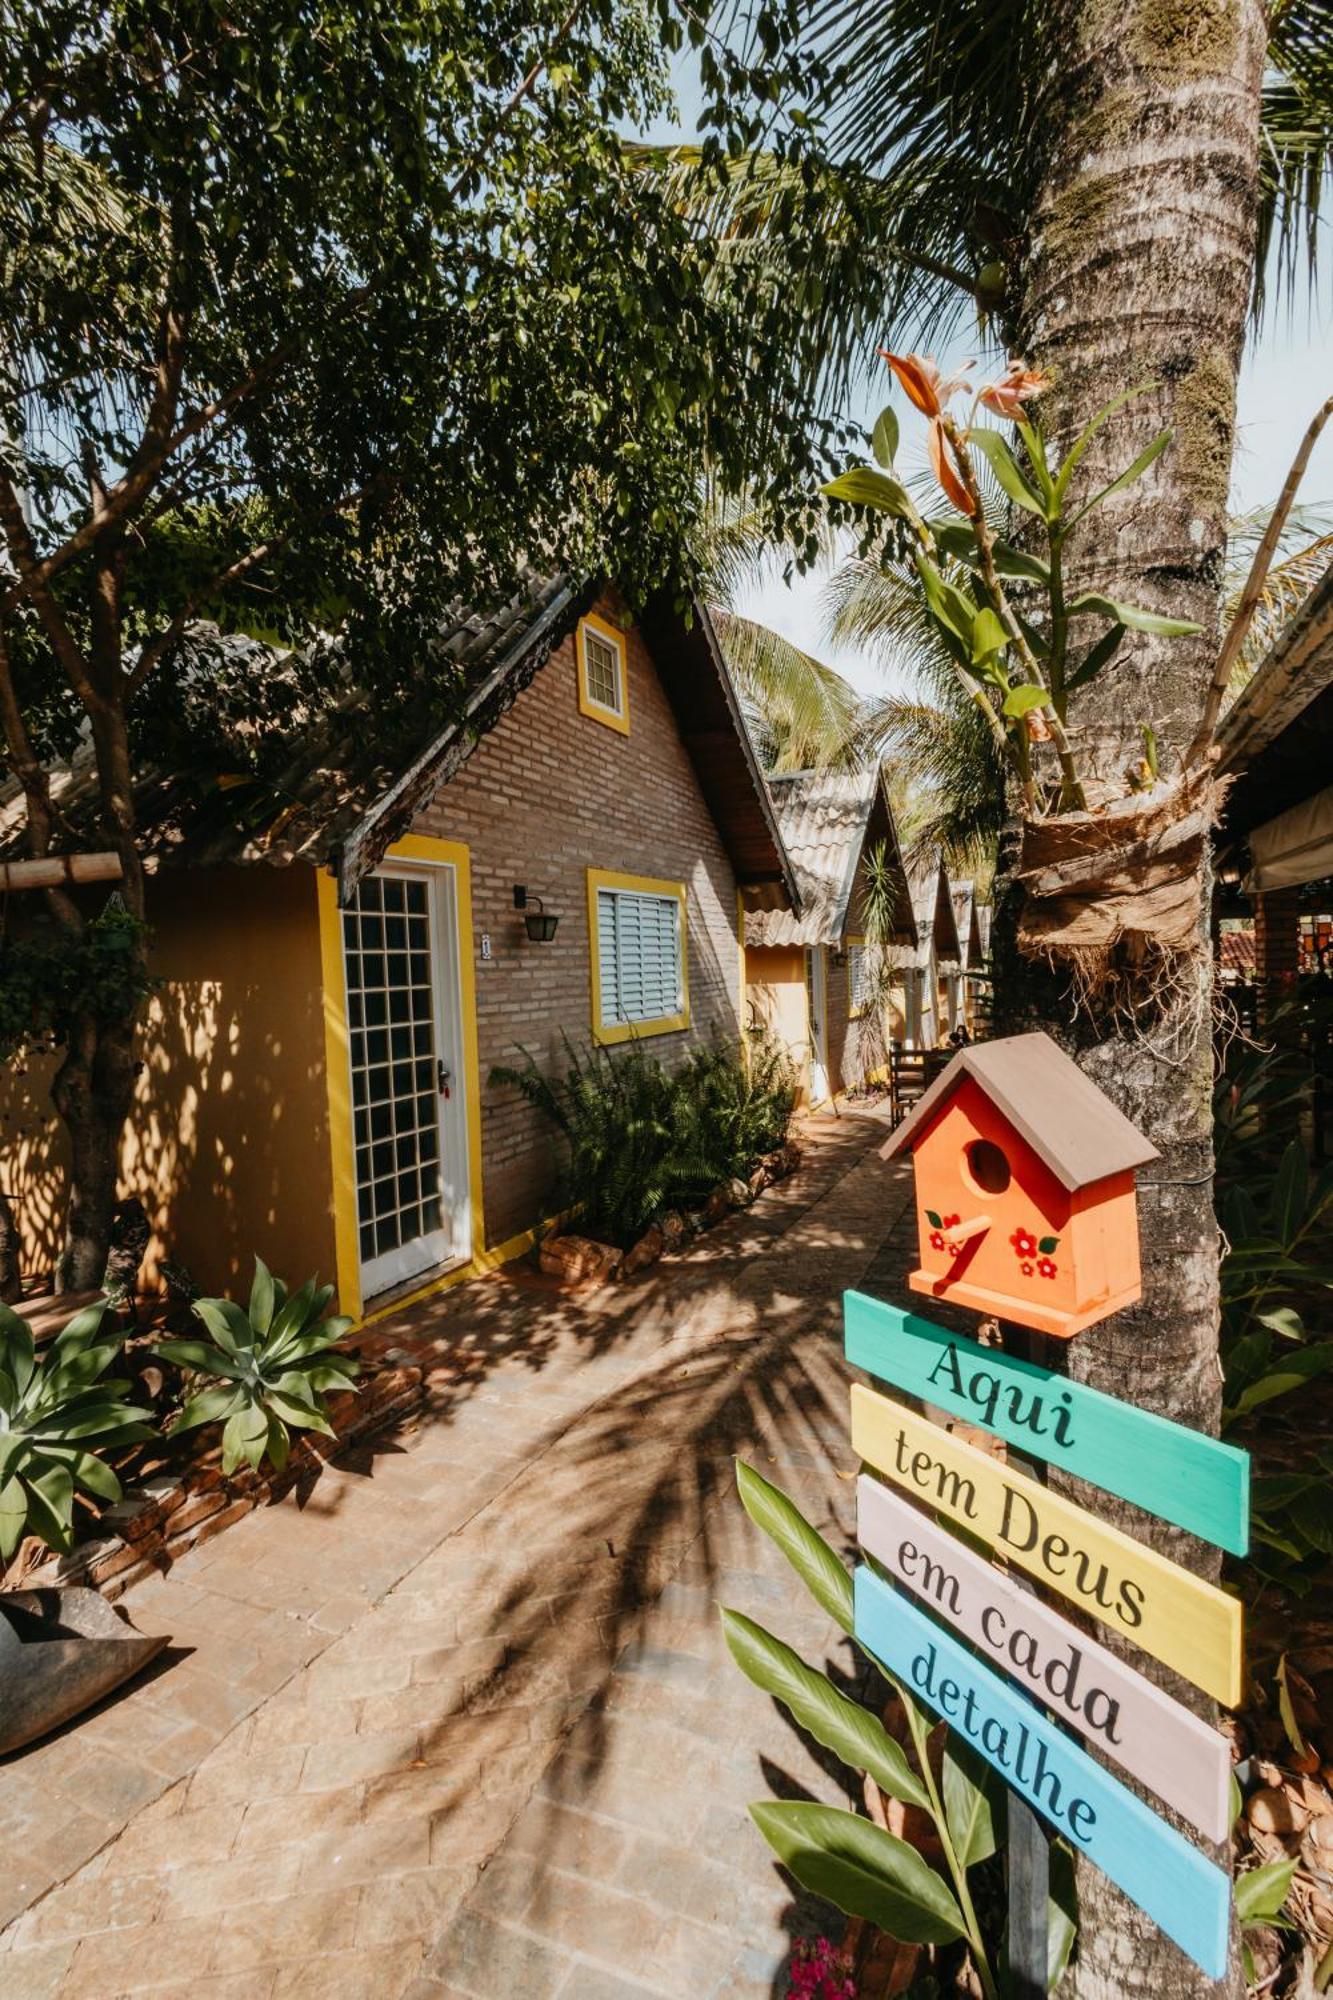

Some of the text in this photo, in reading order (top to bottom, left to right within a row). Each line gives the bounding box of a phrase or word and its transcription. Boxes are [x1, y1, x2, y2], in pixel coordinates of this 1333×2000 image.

[927, 1341, 1075, 1447] Aqui
[895, 1430, 1145, 1627] tem Deus
[898, 1540, 1122, 1745] em cada
[910, 1644, 1097, 1842] detalhe
